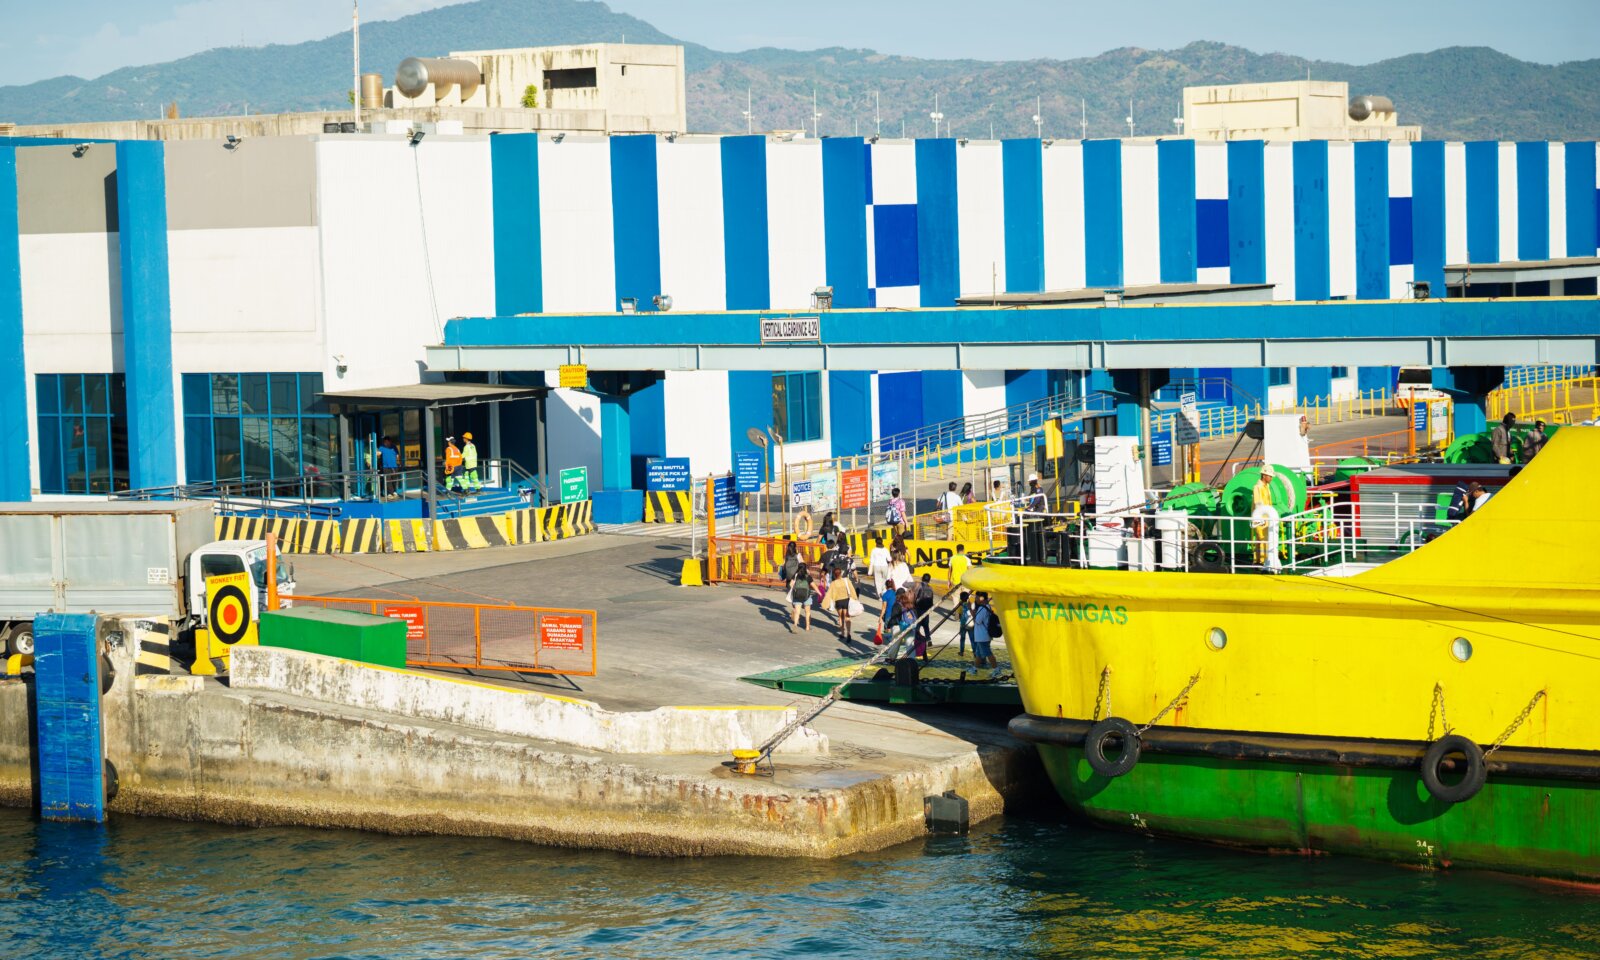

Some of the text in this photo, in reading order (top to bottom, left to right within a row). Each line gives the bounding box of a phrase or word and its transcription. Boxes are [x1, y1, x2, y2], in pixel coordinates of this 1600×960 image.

[762, 322, 782, 337] VERTICAL
[783, 322, 807, 336] CLEARANCE
[793, 482, 811, 493] NOTICE
[916, 547, 953, 569] NO
[210, 576, 233, 584] MONKEY
[1017, 600, 1128, 625] BATANGAS
